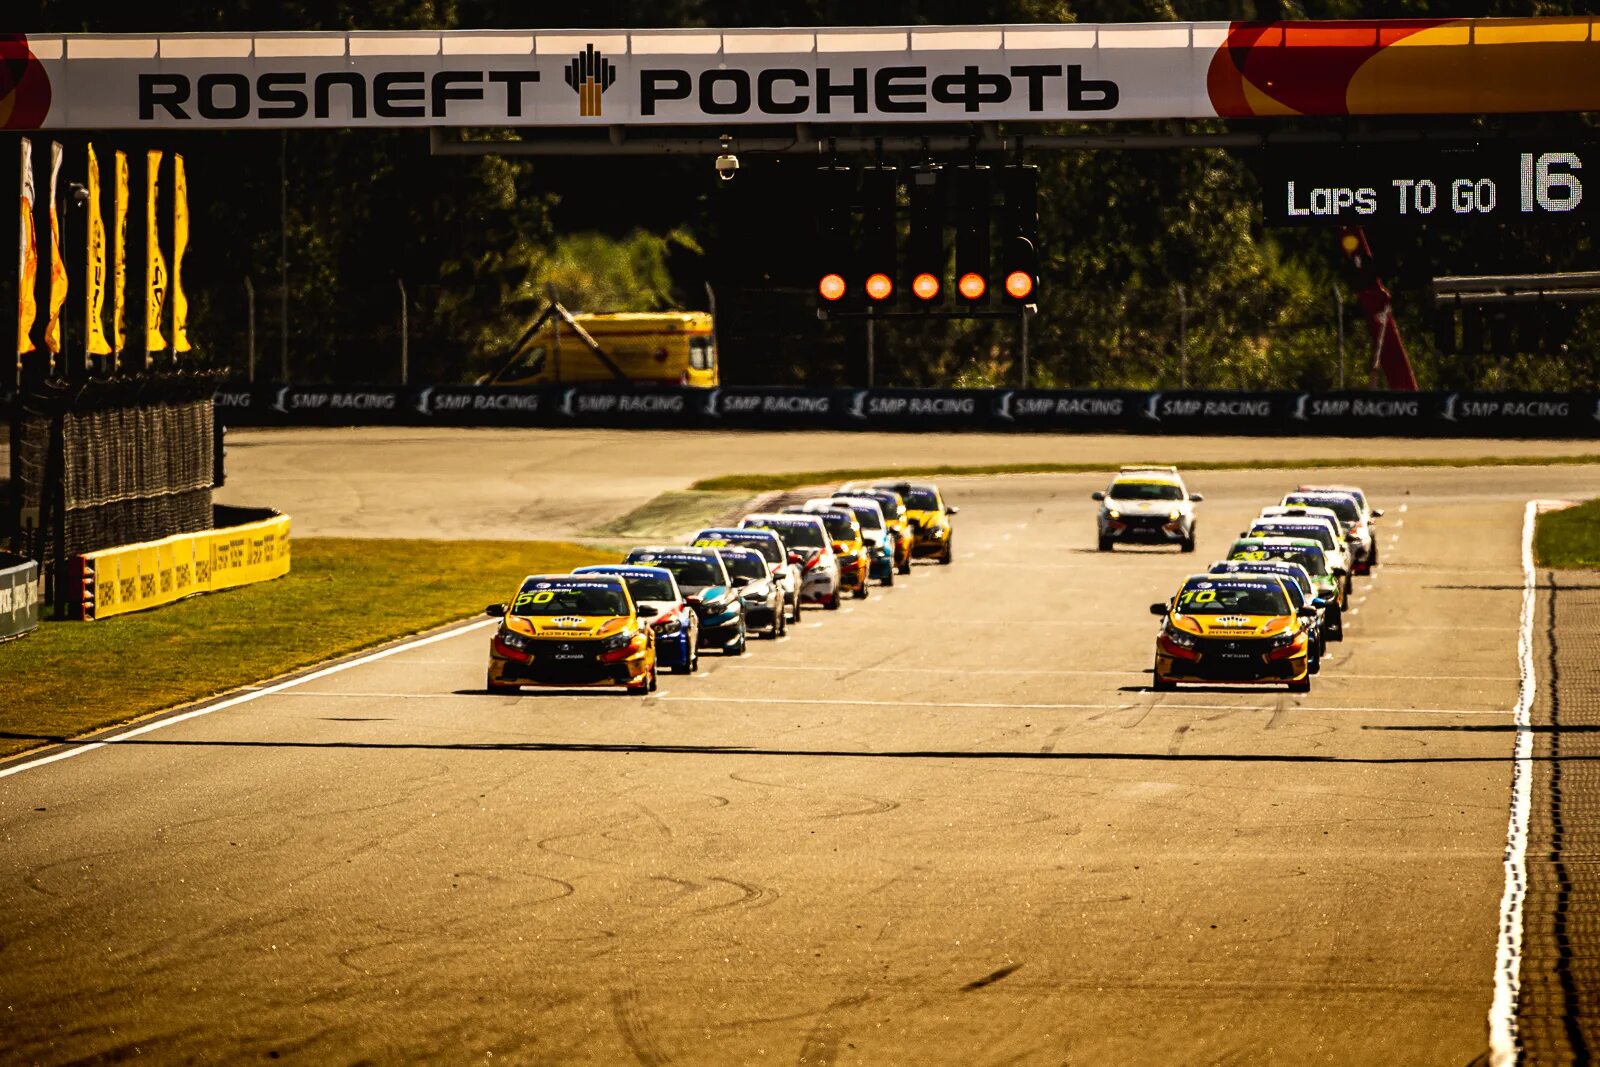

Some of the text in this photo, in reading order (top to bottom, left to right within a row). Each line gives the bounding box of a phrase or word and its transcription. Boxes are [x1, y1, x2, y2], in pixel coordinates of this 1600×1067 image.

[138, 70, 541, 120] ROSNEFT
[640, 64, 1120, 116] РОСНЕФТЬ
[1392, 179, 1436, 215] TO
[1452, 178, 1496, 214] GO
[1520, 152, 1583, 213] 16
[213, 392, 251, 408] CING
[291, 392, 396, 410] SMP RACING
[434, 393, 539, 411] SMP RACING
[578, 394, 684, 412] SMP RACING
[723, 395, 829, 413] SMP RACING
[868, 397, 974, 415] SMP RACING
[1015, 397, 1123, 415] SMP RACING
[1163, 399, 1270, 416] SMP RACING
[1311, 400, 1419, 417] SMP RACING
[1460, 400, 1569, 417] SMP RACING
[515, 591, 555, 606] 50
[1181, 591, 1216, 604] 10
